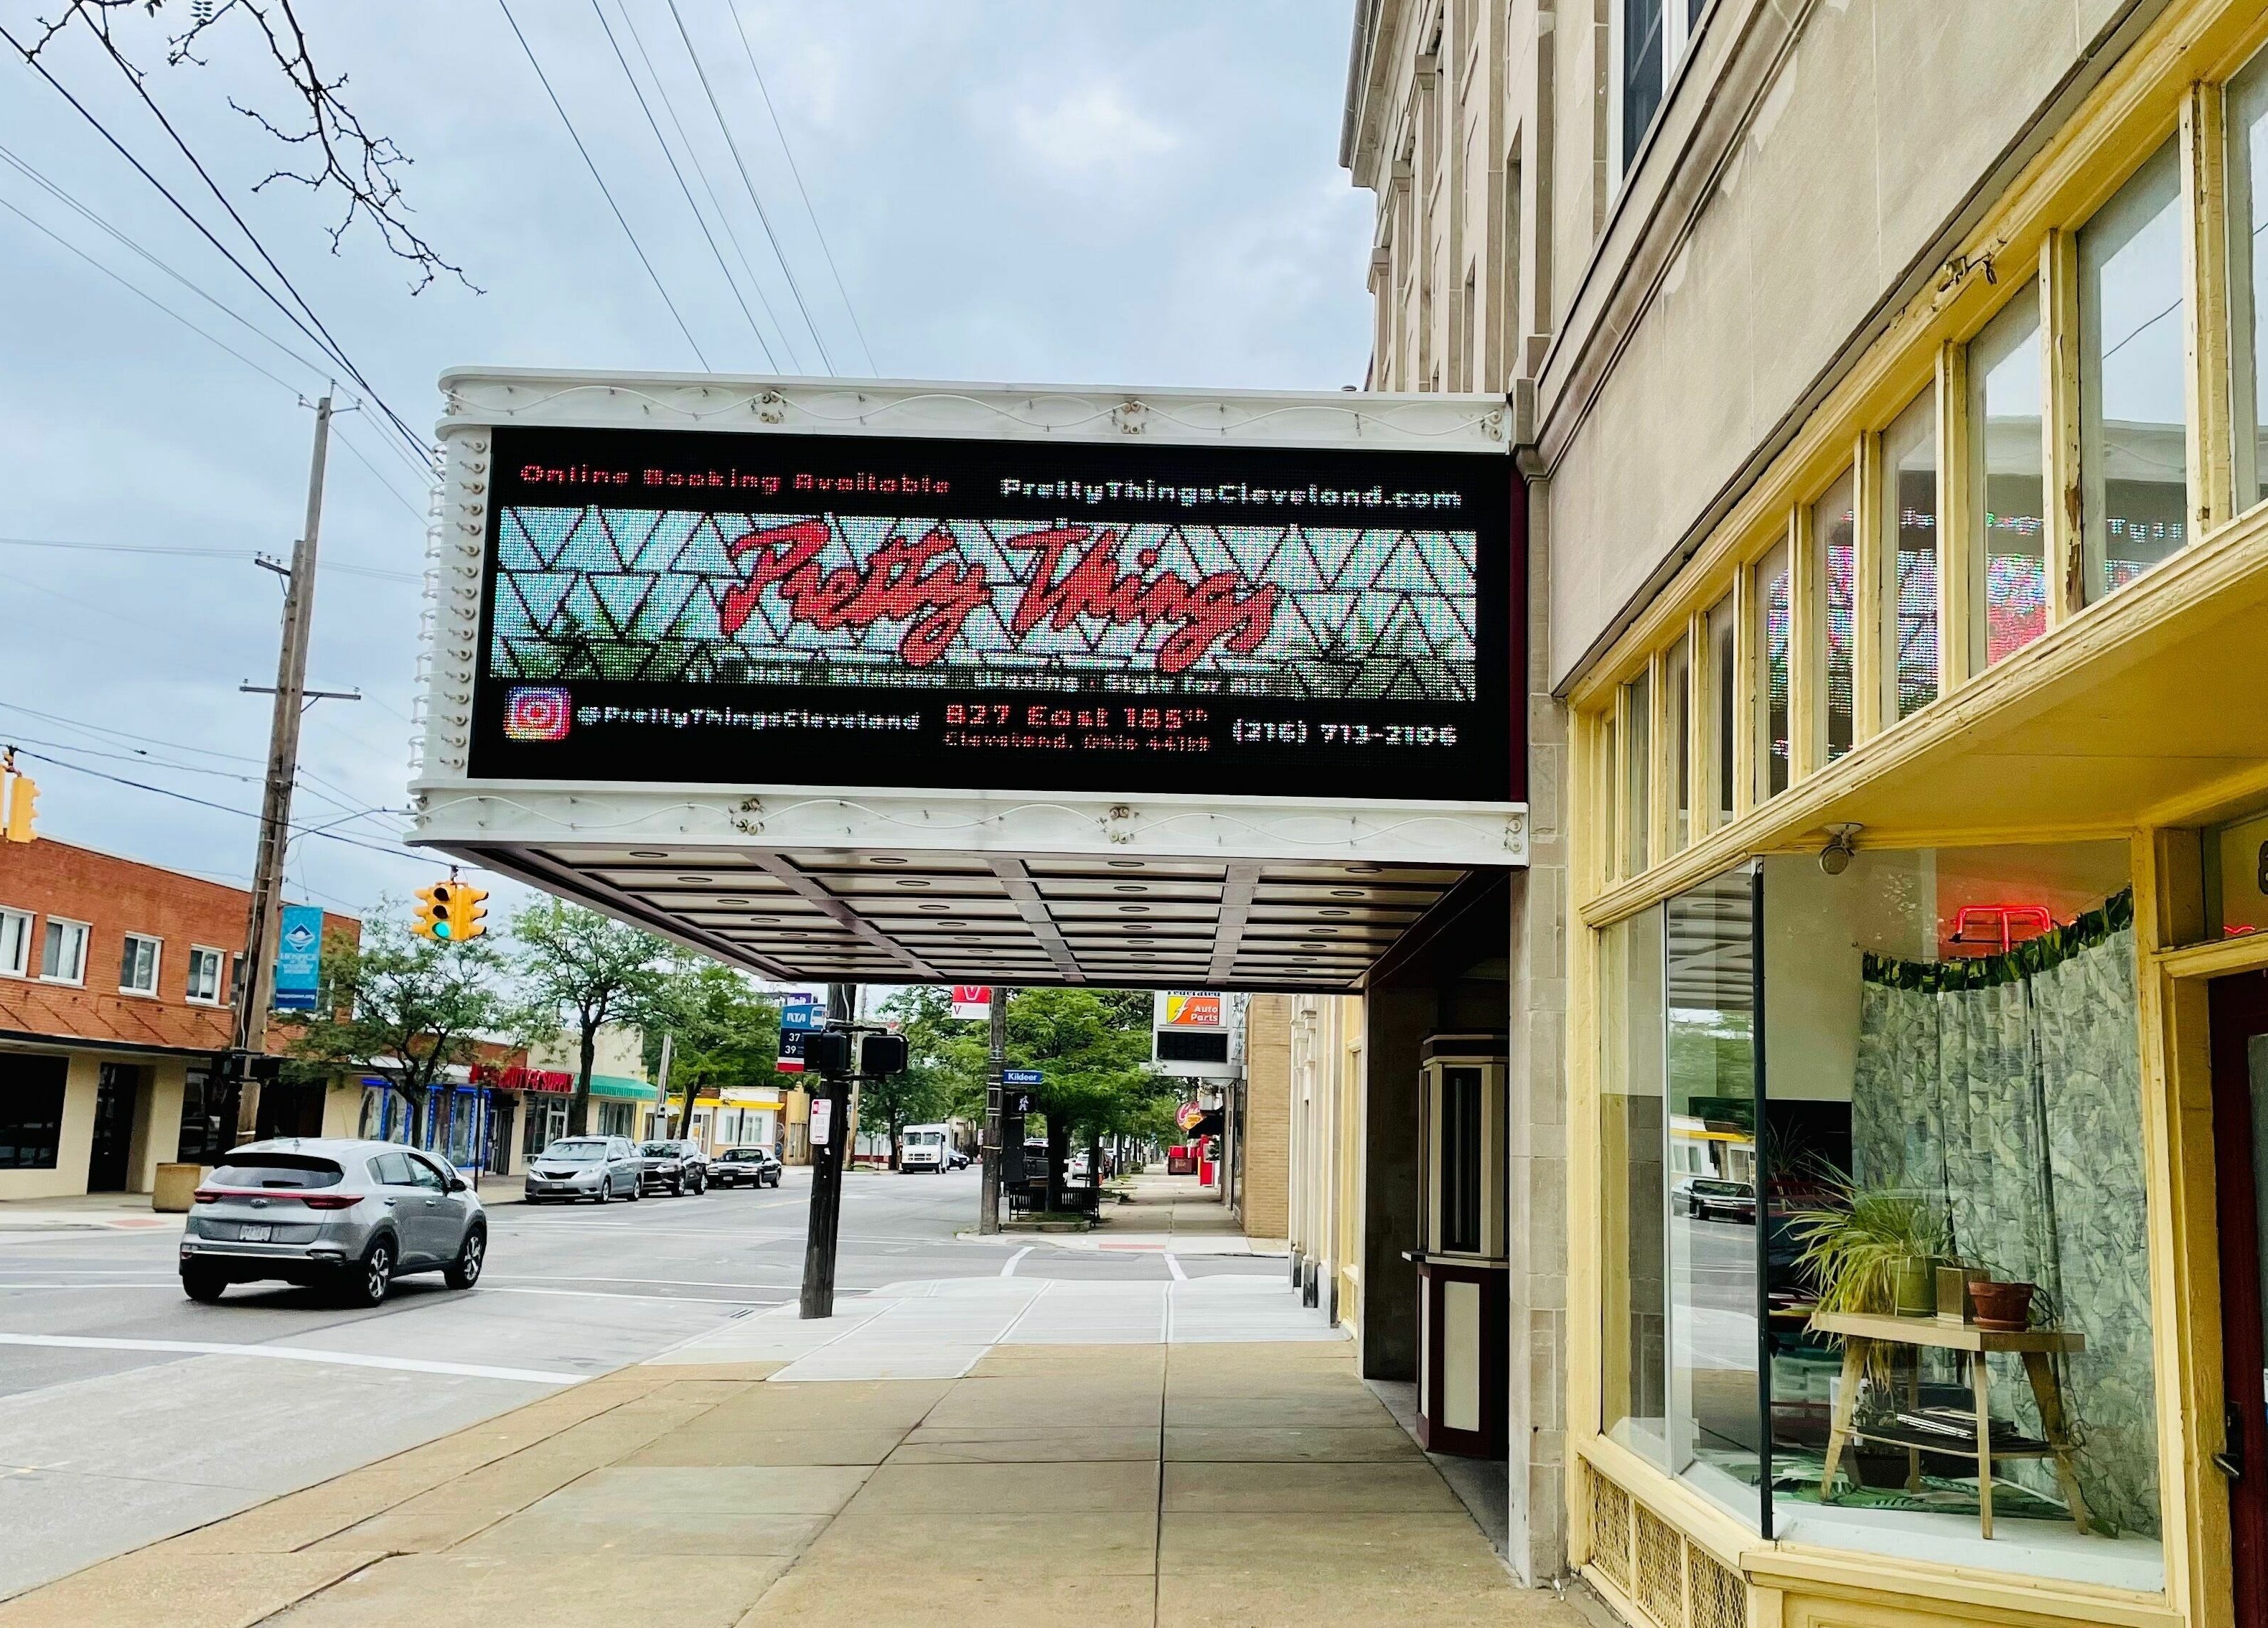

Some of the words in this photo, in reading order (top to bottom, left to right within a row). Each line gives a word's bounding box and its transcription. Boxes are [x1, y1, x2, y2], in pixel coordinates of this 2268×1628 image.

[520, 464, 629, 485] Online
[643, 468, 782, 495] Booking
[792, 472, 950, 495] Available
[1000, 478, 1463, 508] PrettyThingsCleveland.com
[722, 519, 991, 669] Pretty
[1006, 525, 1281, 673] Things
[577, 706, 920, 730] @PrettyThingsCleveland
[945, 703, 1011, 725] 827
[1027, 706, 1108, 728] East
[1232, 718, 1307, 745] (216)
[1318, 723, 1458, 747] 713-2106
[787, 1012, 806, 1022] RTA
[1191, 1013, 1218, 1022] Parts
[1194, 1005, 1218, 1014] Auto
[789, 1032, 800, 1042] 37
[784, 1044, 797, 1054] 39
[1008, 1072, 1038, 1081] Kildeer
